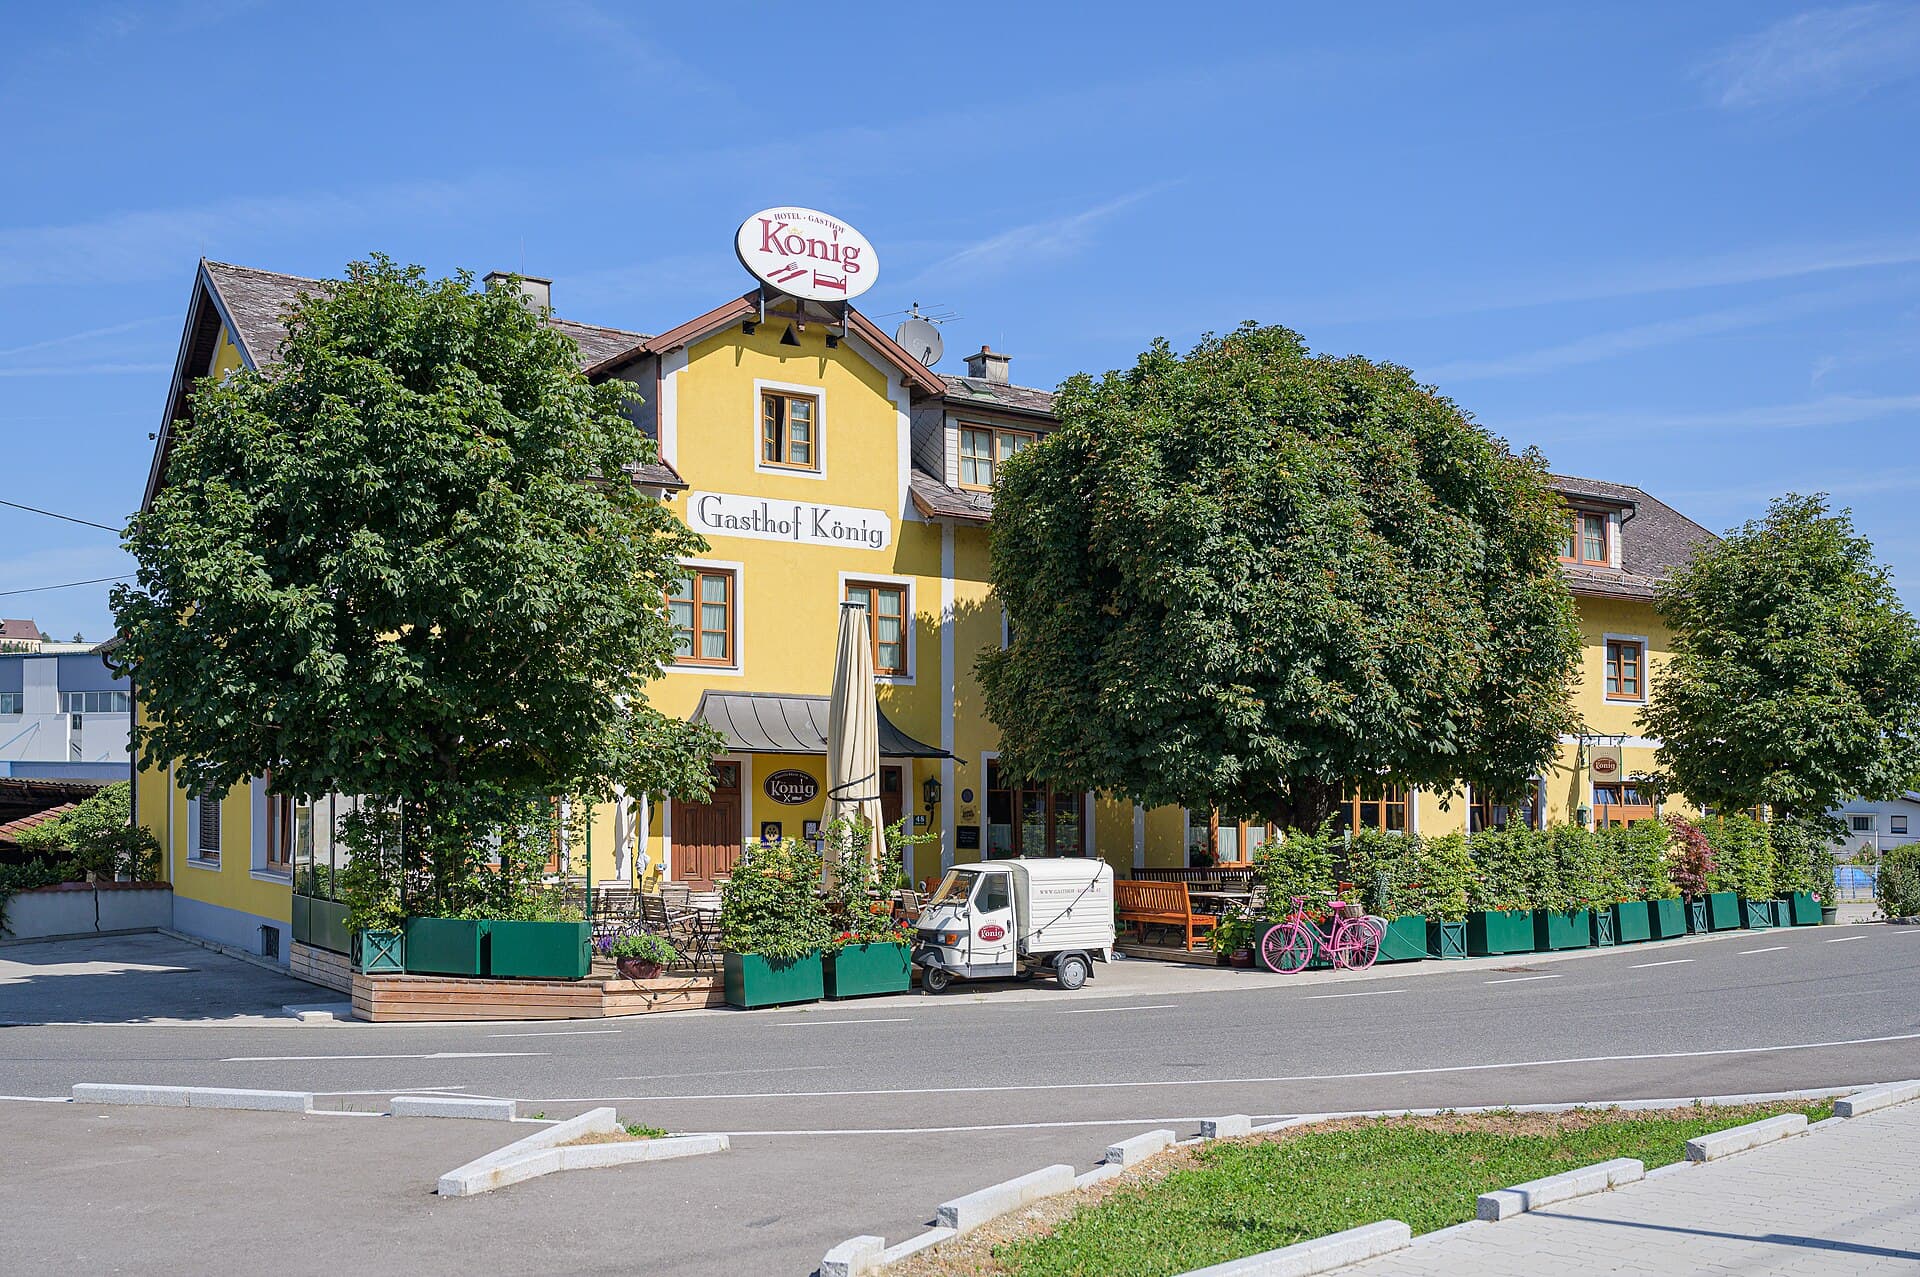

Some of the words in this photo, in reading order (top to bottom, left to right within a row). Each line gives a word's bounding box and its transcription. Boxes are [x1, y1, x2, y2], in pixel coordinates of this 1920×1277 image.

[774, 212, 802, 221] HOTEL
[808, 214, 845, 234] GASTHOF
[697, 495, 802, 540] Gasthof
[811, 507, 884, 549] König
[770, 778, 815, 798] König
